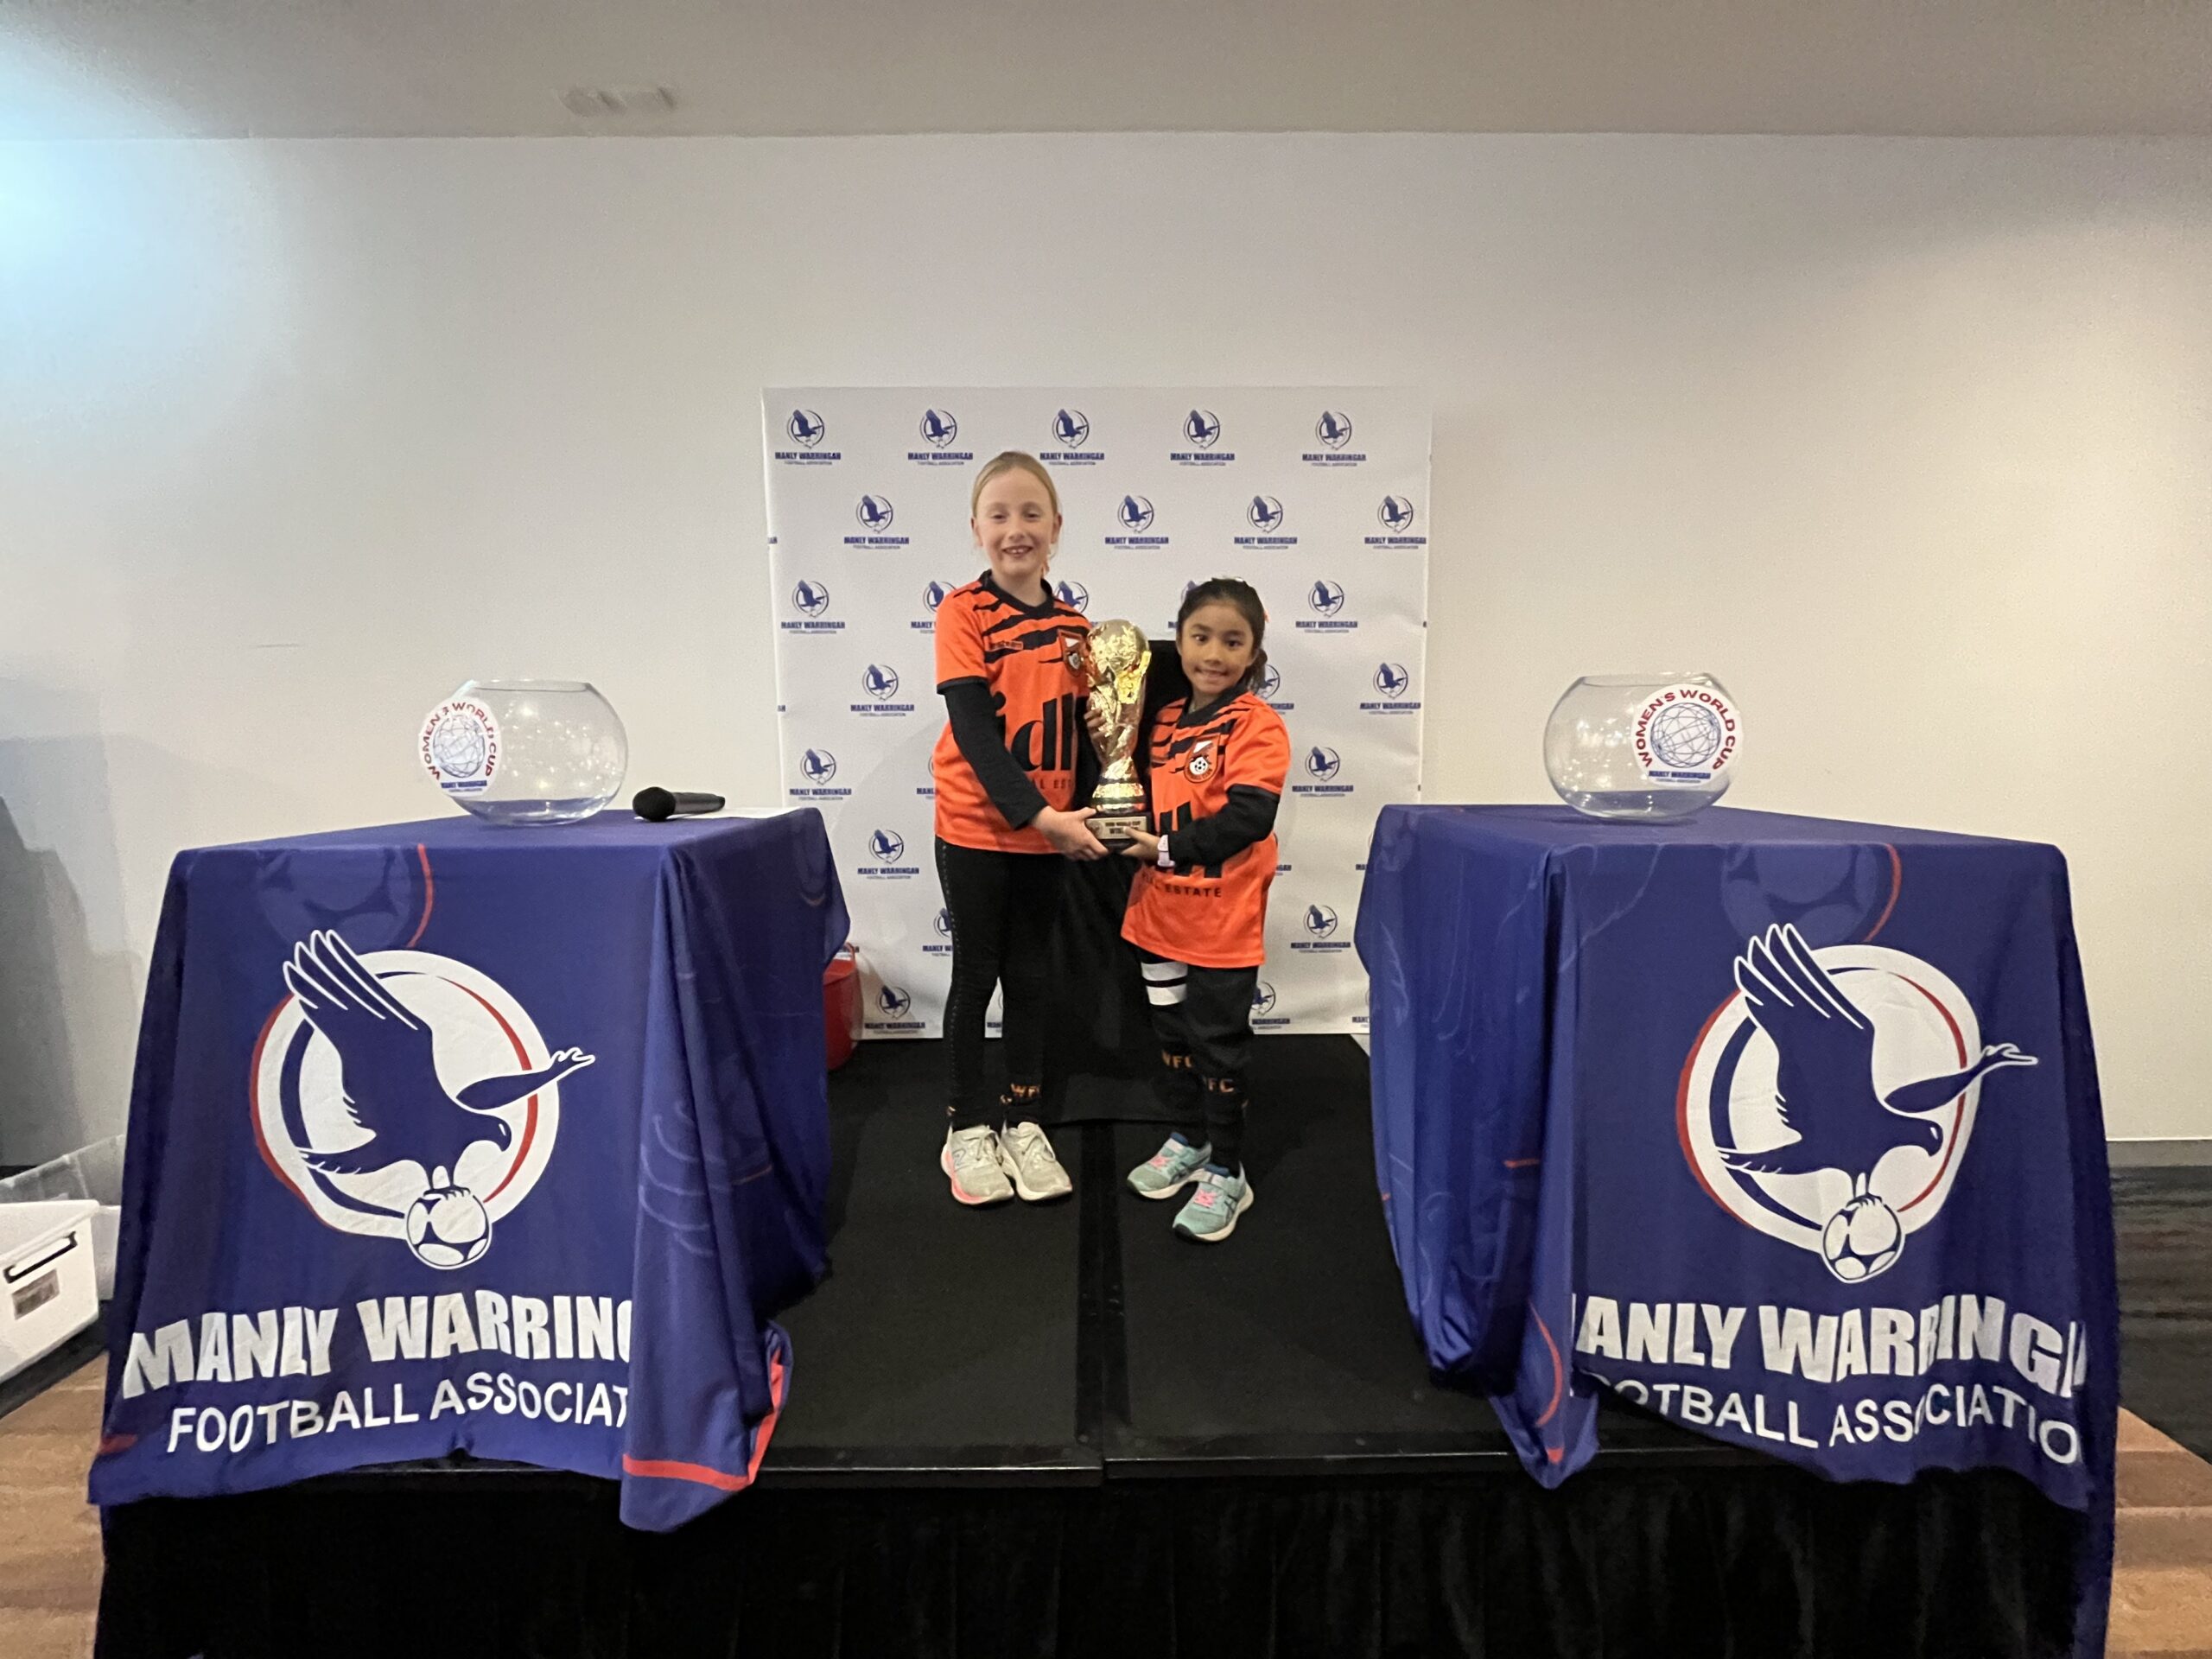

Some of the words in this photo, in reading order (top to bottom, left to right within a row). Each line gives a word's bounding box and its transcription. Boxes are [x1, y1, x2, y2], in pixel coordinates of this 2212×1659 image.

[1679, 690, 1735, 732] WORLD
[1712, 735, 1736, 770] CUP
[1164, 883, 1222, 898] ESTATE
[123, 1306, 339, 1398] MANLY
[1571, 1293, 1747, 1370] ANLY
[167, 1383, 419, 1453] FOOTBALL
